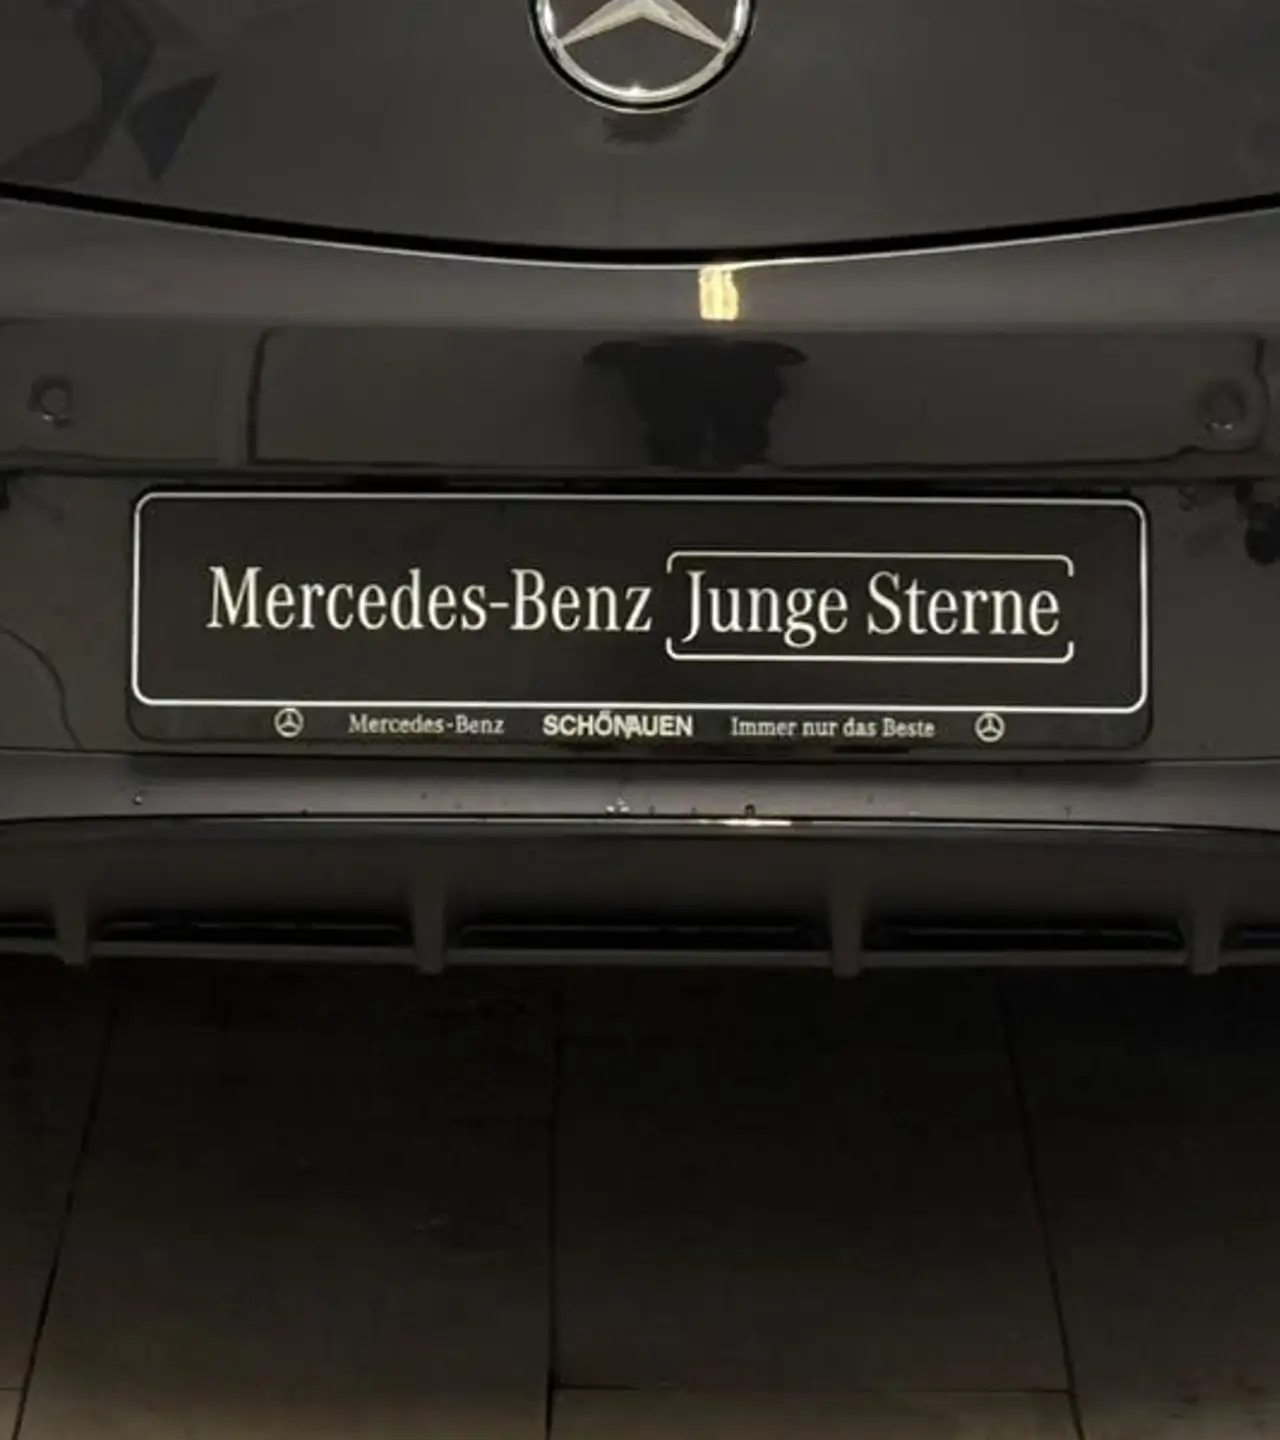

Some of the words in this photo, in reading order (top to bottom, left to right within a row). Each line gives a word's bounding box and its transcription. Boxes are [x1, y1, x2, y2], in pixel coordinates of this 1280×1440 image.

[206, 566, 654, 632] Mercedes-Benz
[681, 570, 849, 649] Junge
[867, 570, 1061, 636] Sterne
[348, 713, 505, 735] Mercedes-Benz
[730, 716, 798, 737] Immer
[802, 719, 837, 737] nur
[843, 717, 877, 737] das
[882, 717, 936, 738] Beste
